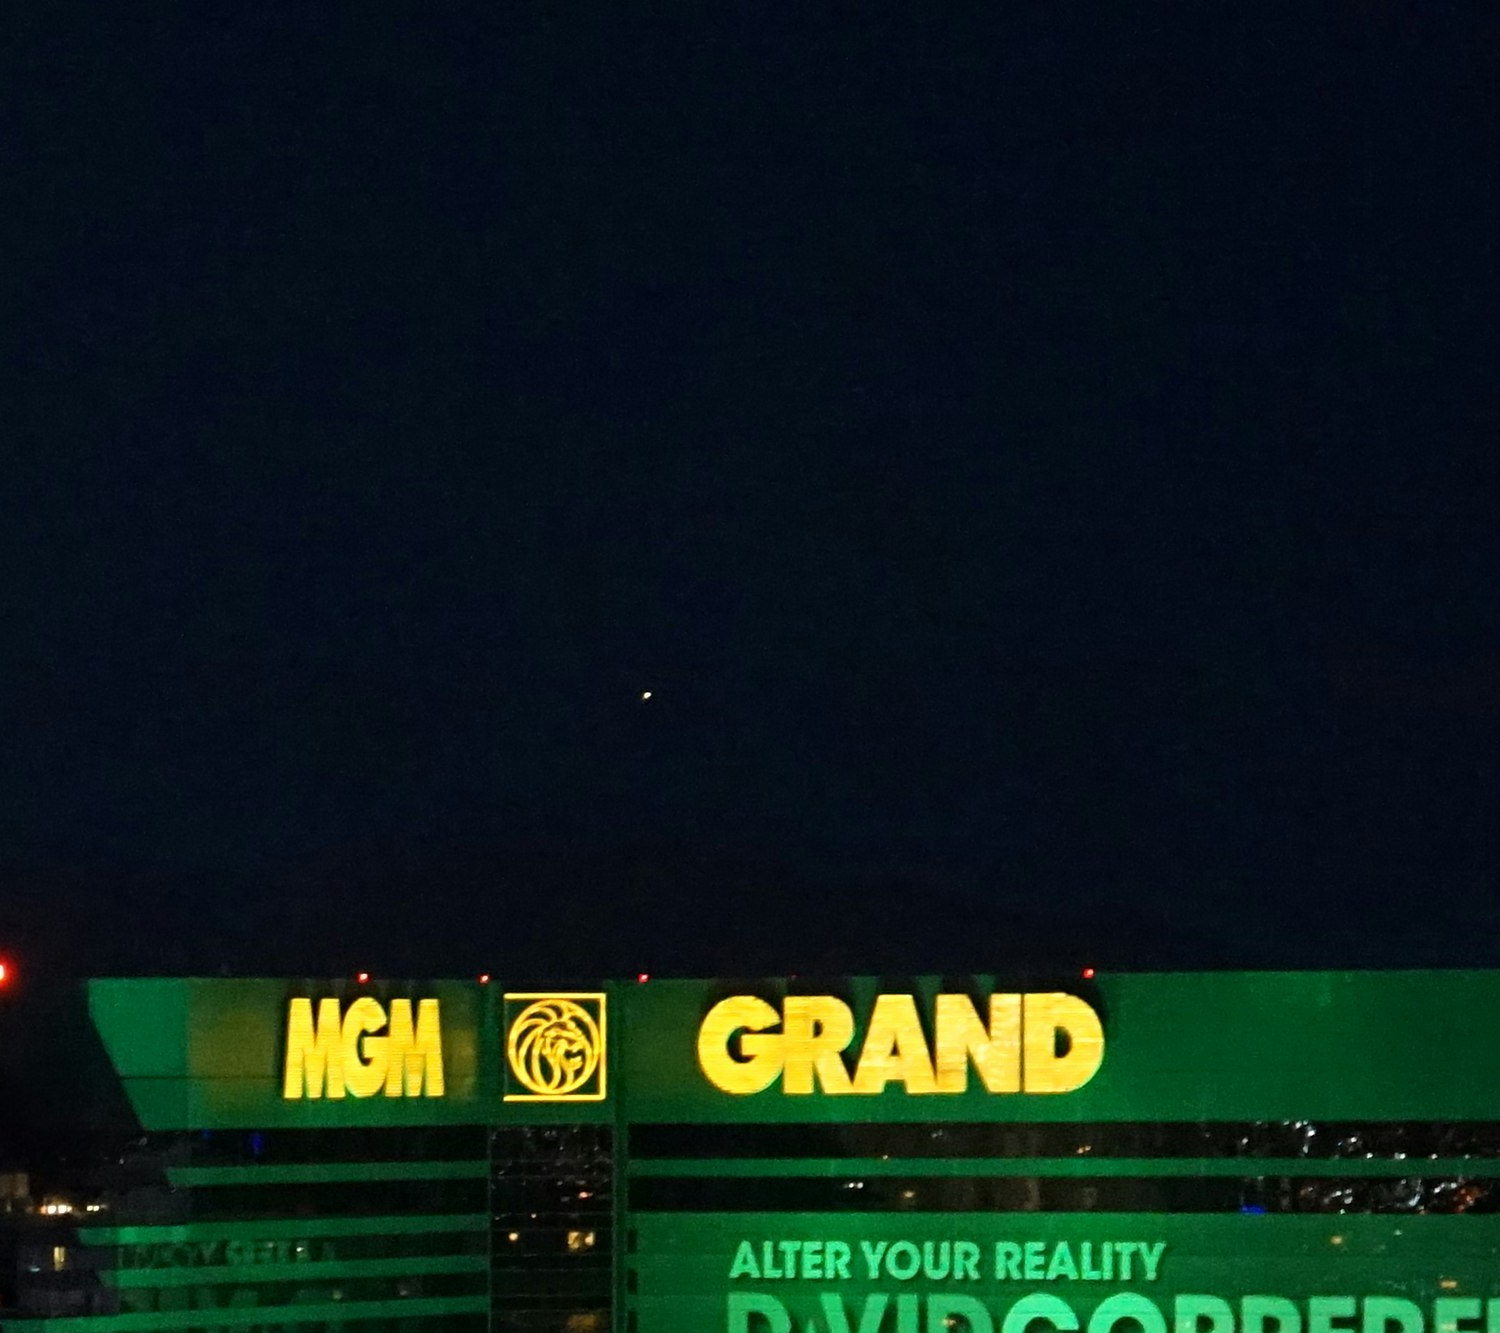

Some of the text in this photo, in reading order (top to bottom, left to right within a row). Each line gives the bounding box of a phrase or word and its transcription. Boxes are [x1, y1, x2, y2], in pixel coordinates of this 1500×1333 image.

[283, 991, 1105, 1100] MGM GRAND
[728, 1240, 1167, 1282] ALTER YOUR REALITY
